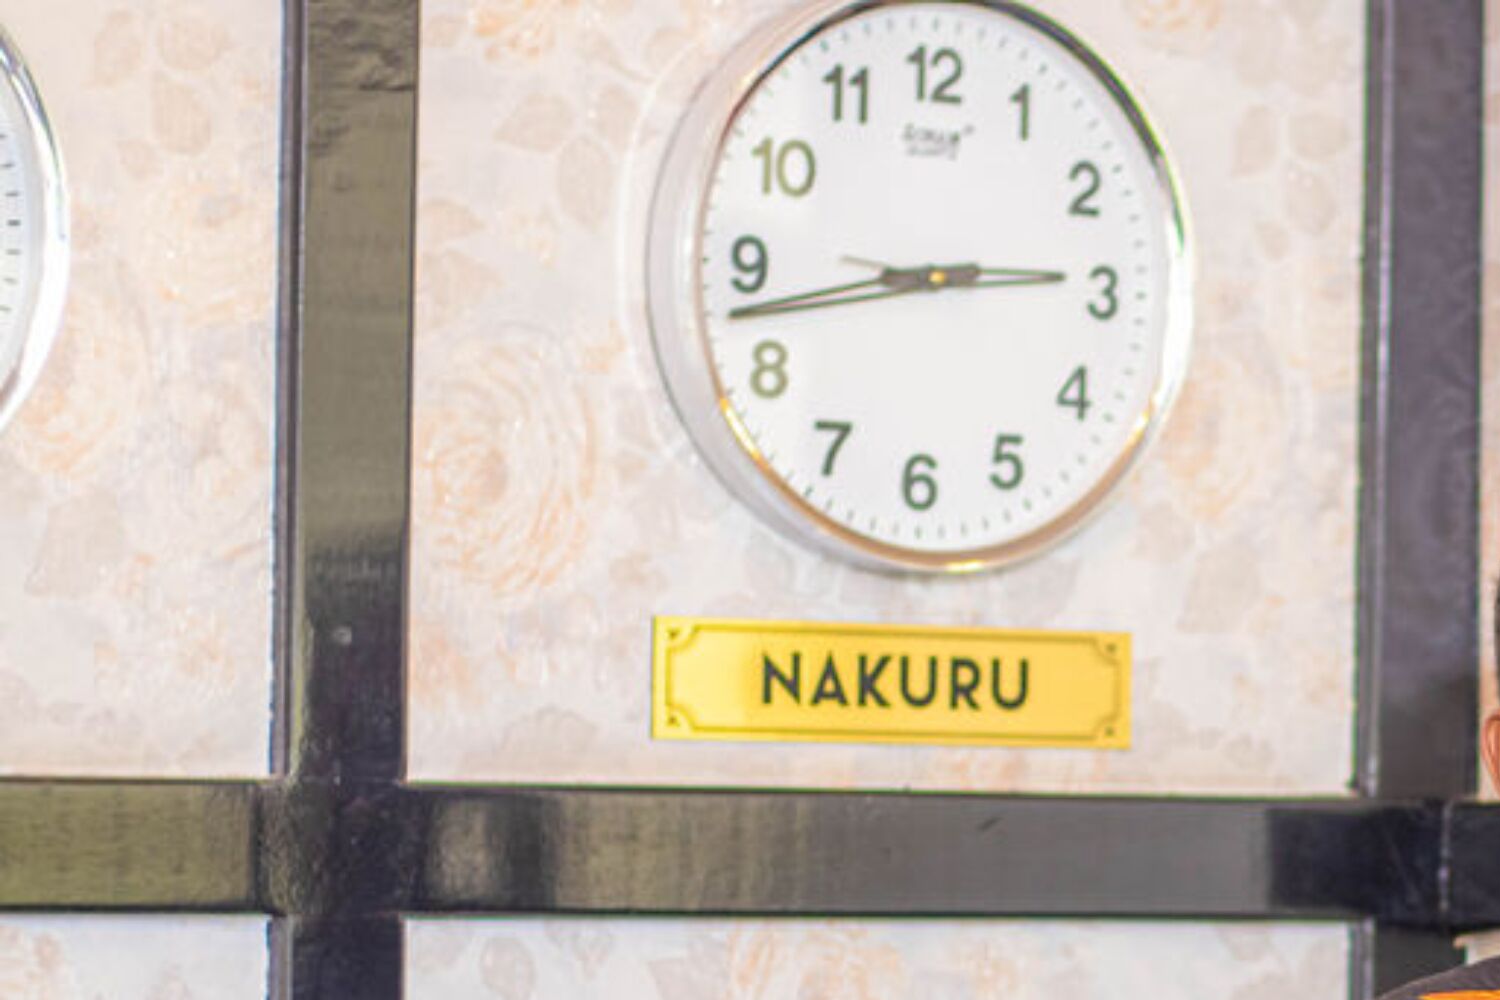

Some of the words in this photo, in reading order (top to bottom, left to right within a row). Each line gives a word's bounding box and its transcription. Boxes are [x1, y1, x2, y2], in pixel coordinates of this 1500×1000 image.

[823, 63, 869, 125] 11
[906, 45, 964, 105] 12
[1010, 83, 1031, 142] 1
[751, 137, 817, 199] 10
[1068, 160, 1101, 218] 2
[730, 234, 769, 295] 9
[1086, 265, 1119, 321] 3
[749, 339, 789, 400] 8
[1056, 365, 1092, 421] 4
[814, 420, 853, 477] 7
[989, 433, 1025, 491] 5
[901, 453, 938, 512] 6
[762, 652, 1029, 711] NAKURU
